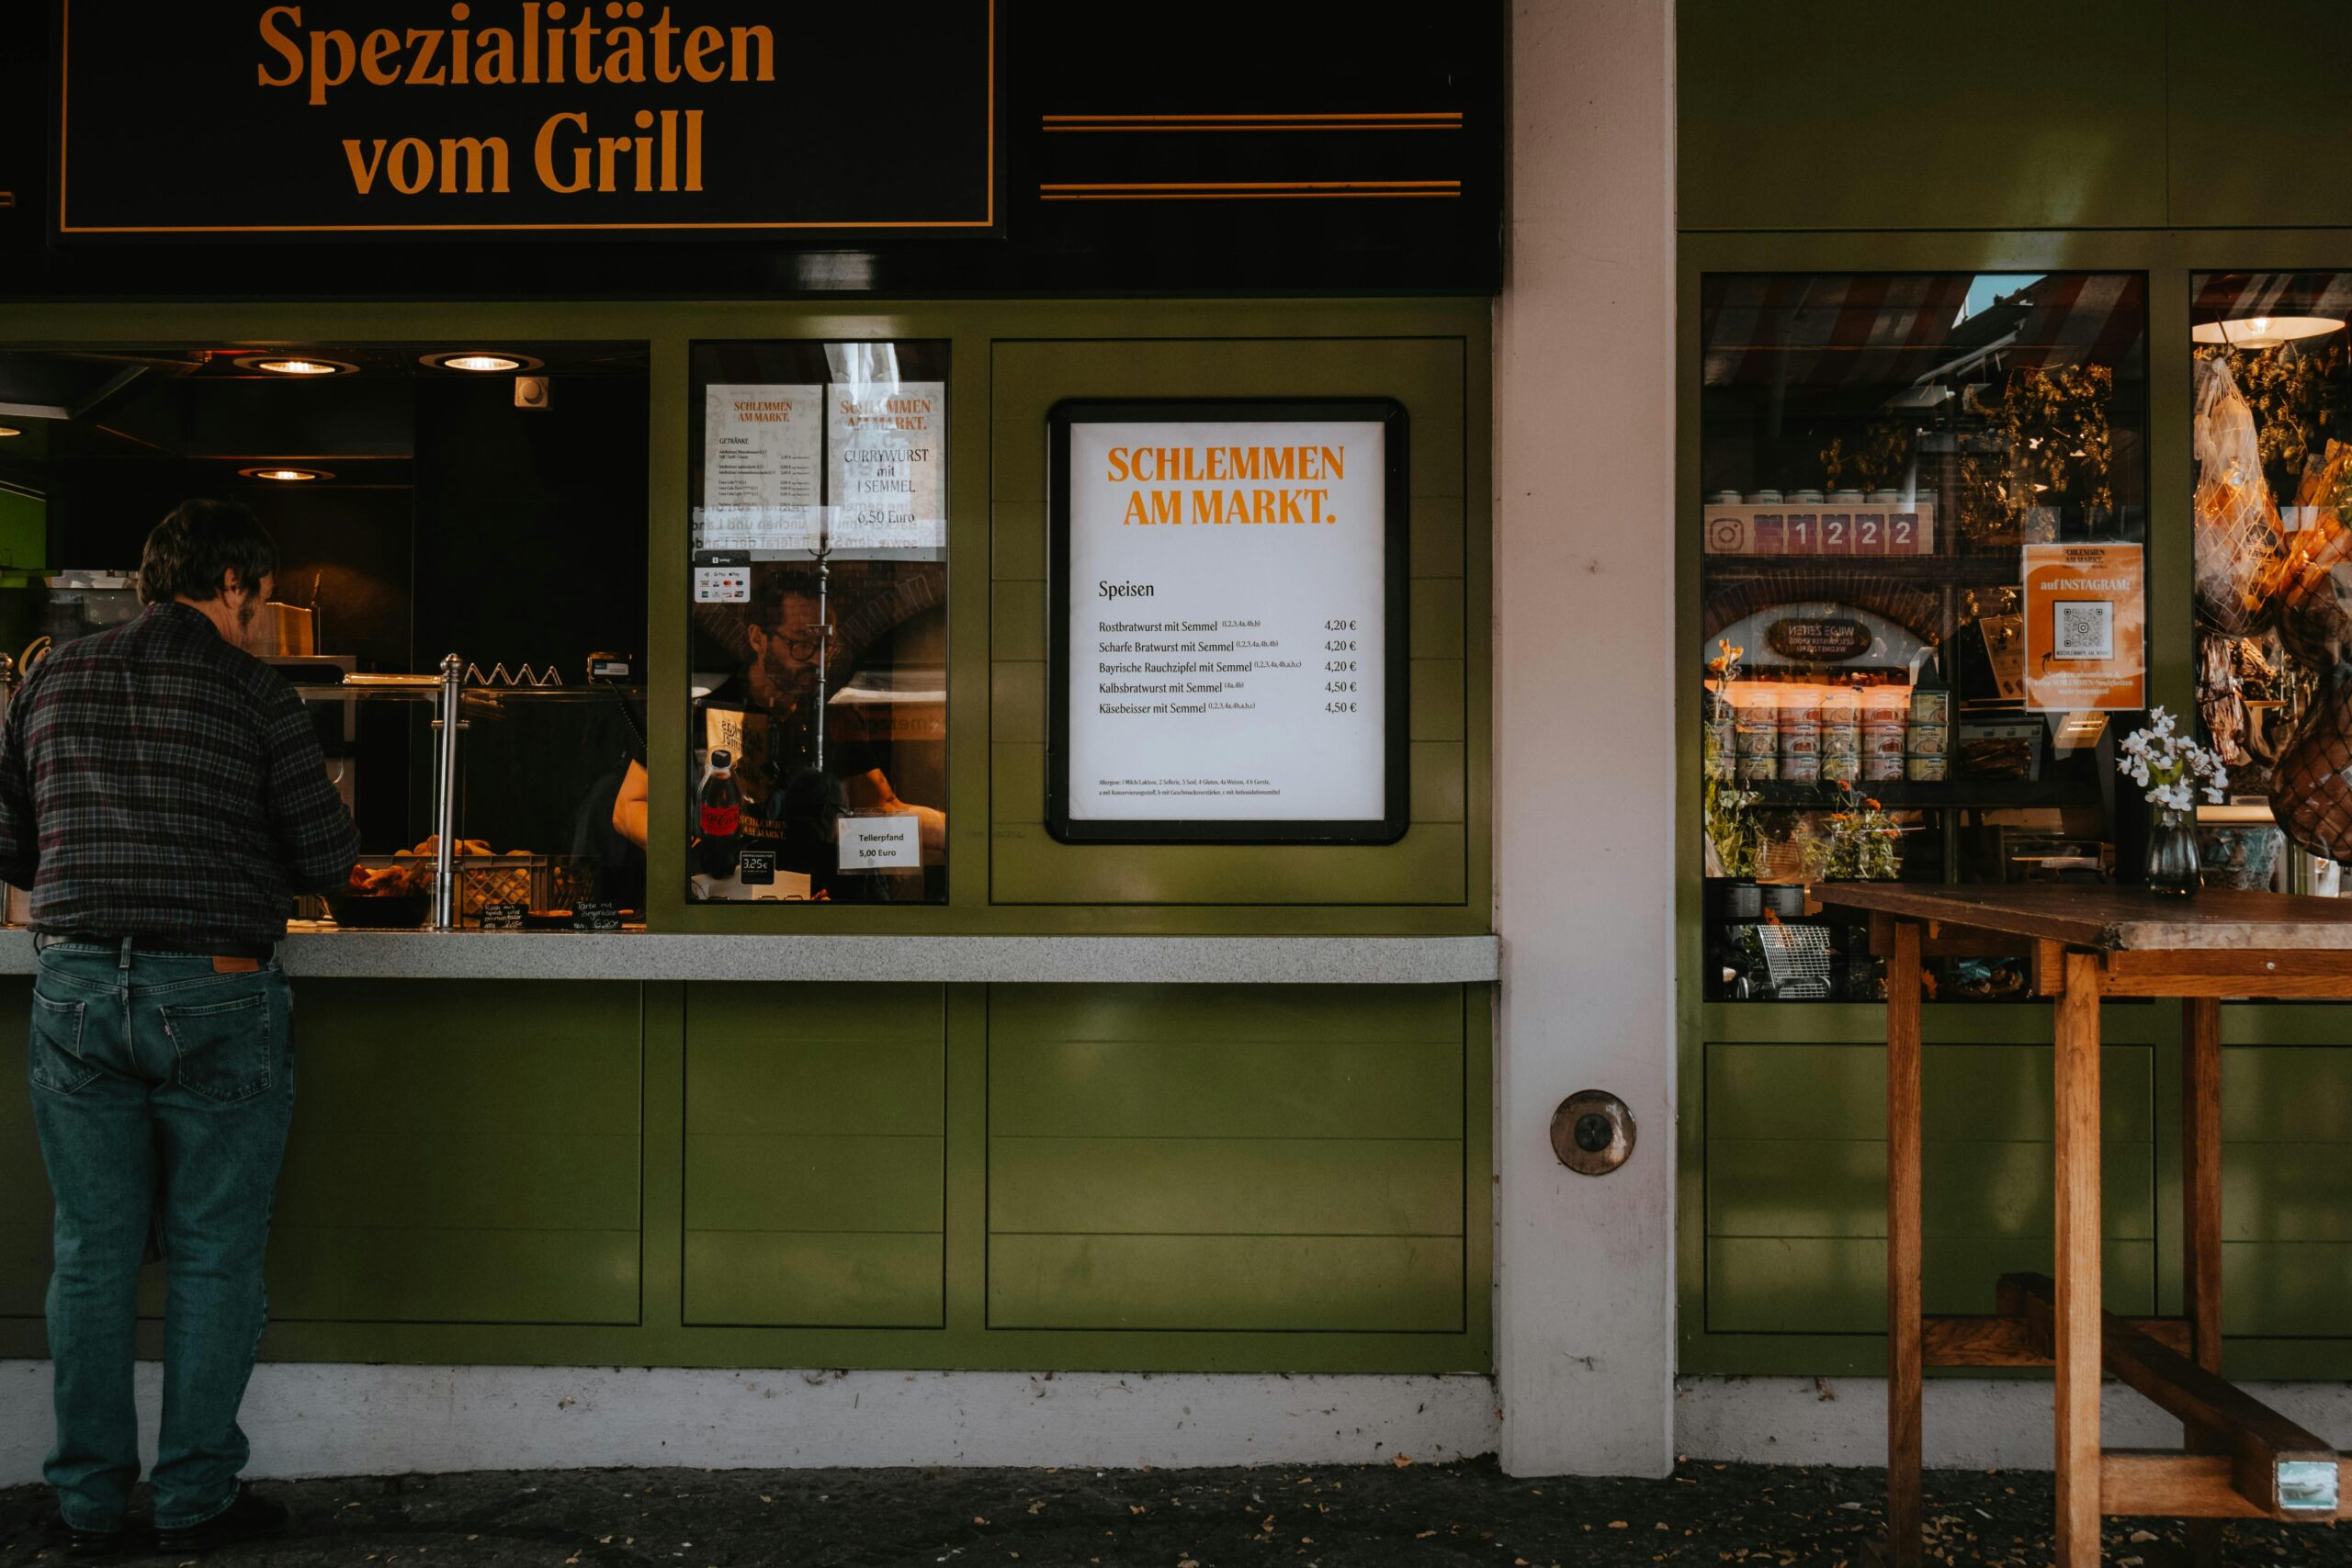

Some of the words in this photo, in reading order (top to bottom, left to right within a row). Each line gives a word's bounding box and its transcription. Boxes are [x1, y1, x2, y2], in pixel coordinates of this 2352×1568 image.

[258, 2, 775, 106] Spezialitäten
[342, 137, 511, 195] vom
[535, 110, 704, 194] Grill
[734, 401, 792, 412] SCHLEMMEN
[841, 398, 931, 414] SCHLMMEN
[738, 412, 752, 422] AM
[754, 412, 790, 423] MARKT.
[844, 448, 929, 462] CURRYWURST
[1107, 446, 1345, 482] SCHLEMMEN
[876, 465, 896, 478] mit
[865, 479, 916, 493] SEMMEL
[1123, 490, 1183, 526] AM
[1192, 488, 1338, 525] MARKT.
[857, 512, 885, 525] 6,50
[888, 511, 915, 524] Euro
[2063, 548, 2106, 557] SCHLEMMEN
[2041, 580, 2059, 591] auf
[2061, 578, 2131, 591] INSTAGRAM:
[1099, 581, 1155, 602] Speisen
[1099, 621, 1162, 632] Rostbratwurst
[1164, 621, 1181, 632] mit
[1182, 621, 1218, 632] Semmel
[1325, 620, 1347, 632] 4,20
[1349, 620, 1357, 631] €
[1099, 641, 1133, 652] Scharfe
[1135, 641, 1179, 652] Bratwurst
[1181, 641, 1197, 652] mit
[1198, 641, 1234, 652] Semmel
[1325, 640, 1347, 652] 4,20
[1349, 641, 1357, 651] €
[1099, 662, 1143, 675] Bayrische
[1144, 661, 1197, 675] Rauchzipfel
[1199, 661, 1215, 672] mit
[1216, 661, 1252, 672] Semmel
[1325, 661, 1347, 672] 4,20
[1350, 661, 1358, 671] €
[1099, 682, 1167, 694] Kalbsbratwurst
[1169, 682, 1184, 694] mit
[1186, 682, 1223, 693] Semmel
[1325, 682, 1348, 694] 4,50
[1350, 682, 1358, 693] €
[1099, 702, 1152, 714] Käsebeisser
[1153, 703, 1169, 714] mit
[1170, 702, 1206, 714] Semmel
[1325, 702, 1348, 714] 4,50
[1350, 703, 1358, 714] €
[859, 833, 904, 843] Tellerpfand
[859, 850, 876, 859] 5,00
[576, 901, 597, 909] Tarte
